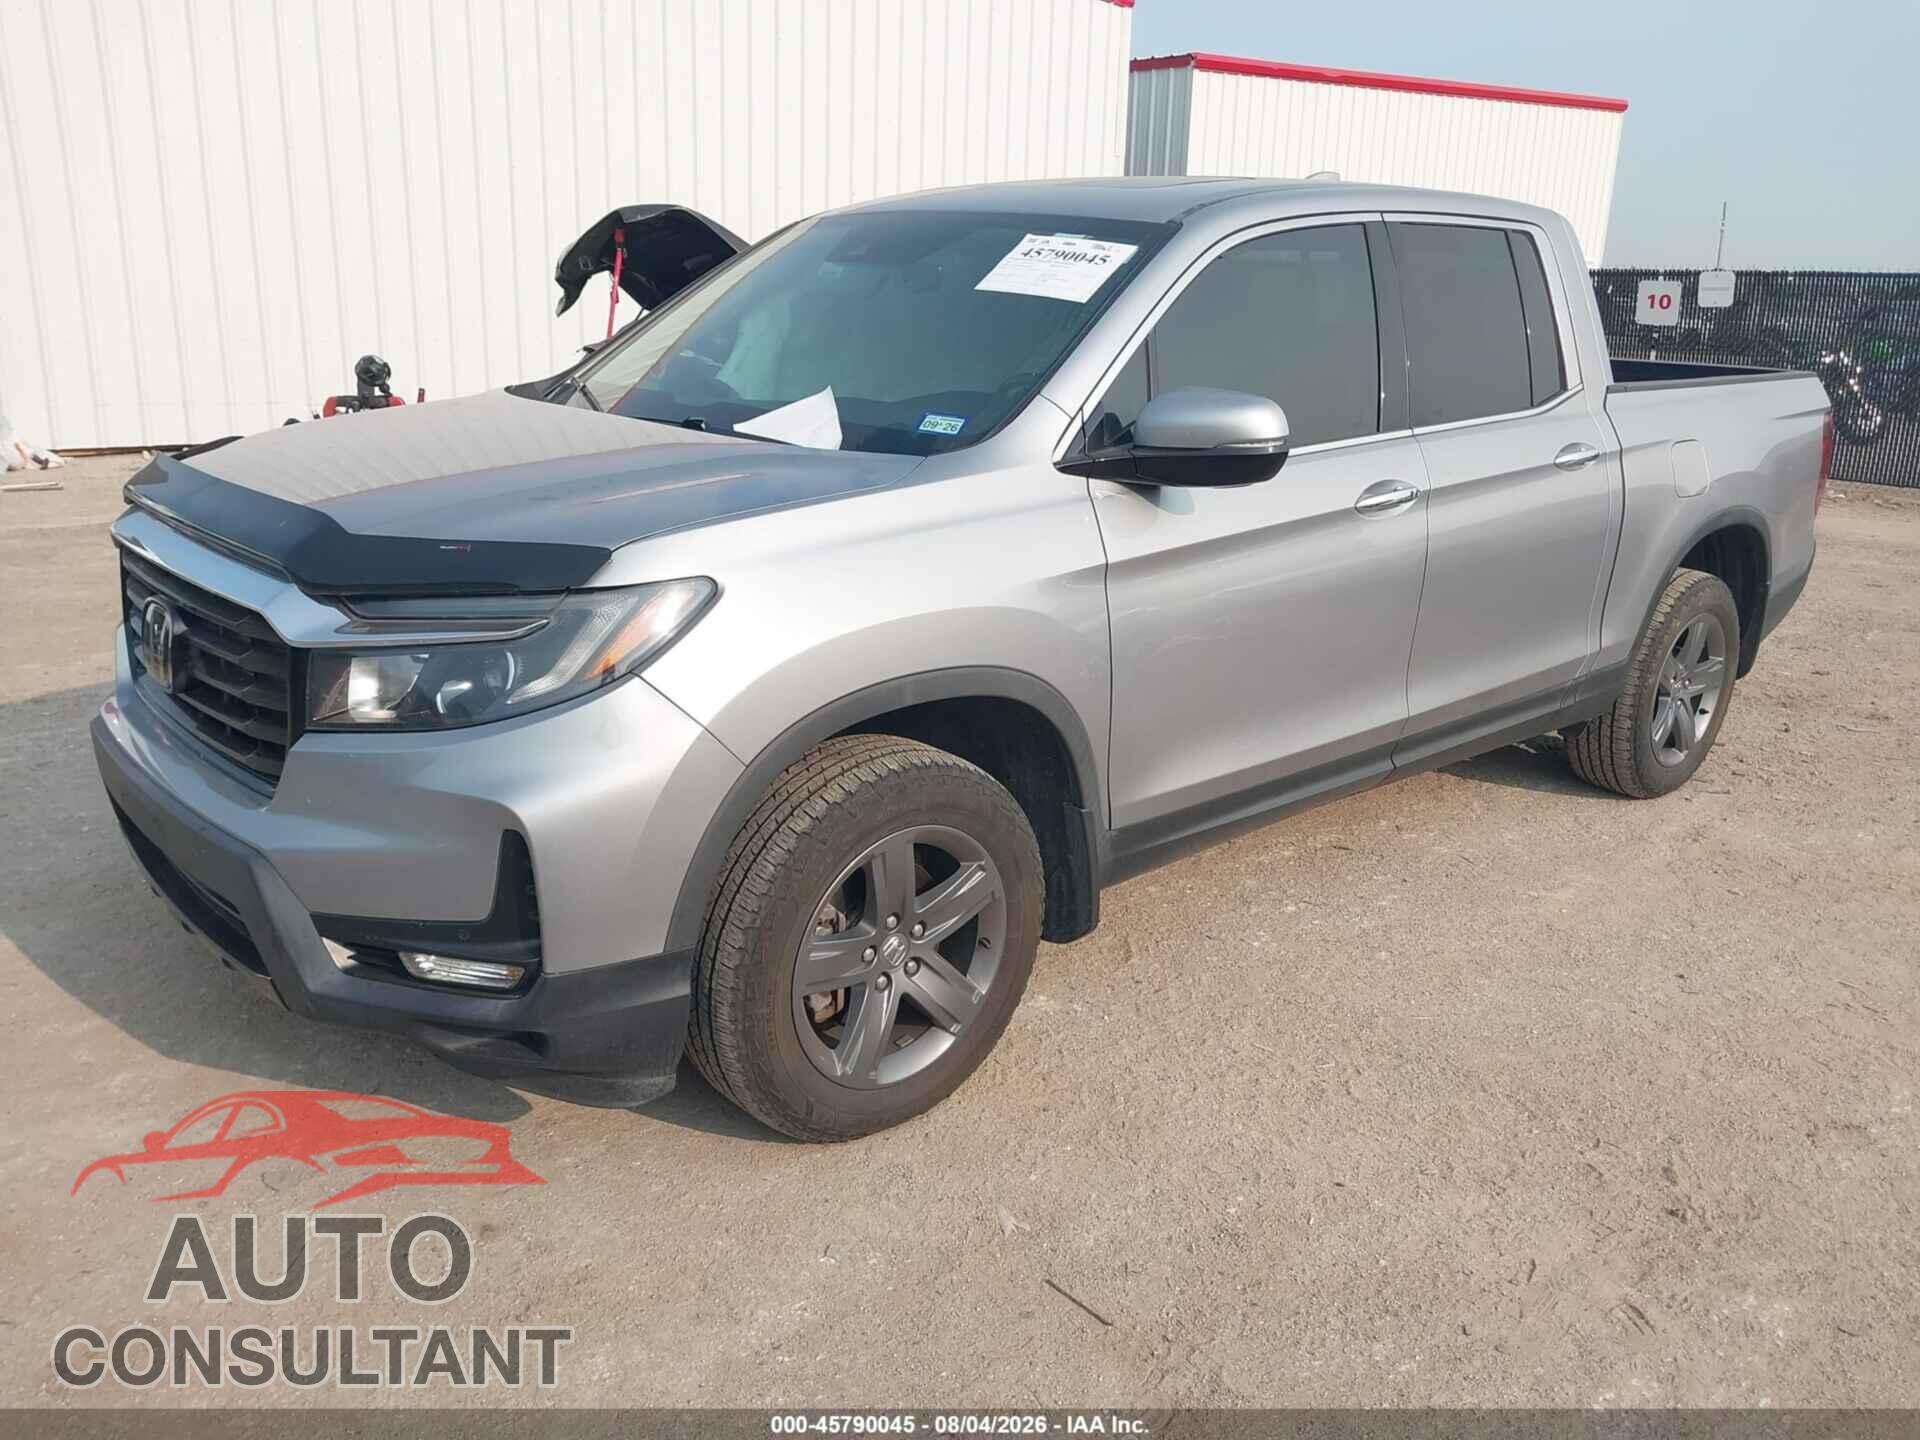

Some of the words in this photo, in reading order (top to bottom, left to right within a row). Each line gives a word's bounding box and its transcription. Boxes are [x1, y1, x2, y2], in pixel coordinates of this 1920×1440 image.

[1021, 246, 1112, 266] 45790045
[1647, 294, 1671, 309] 10
[923, 420, 938, 429] 09
[943, 422, 960, 432] 26
